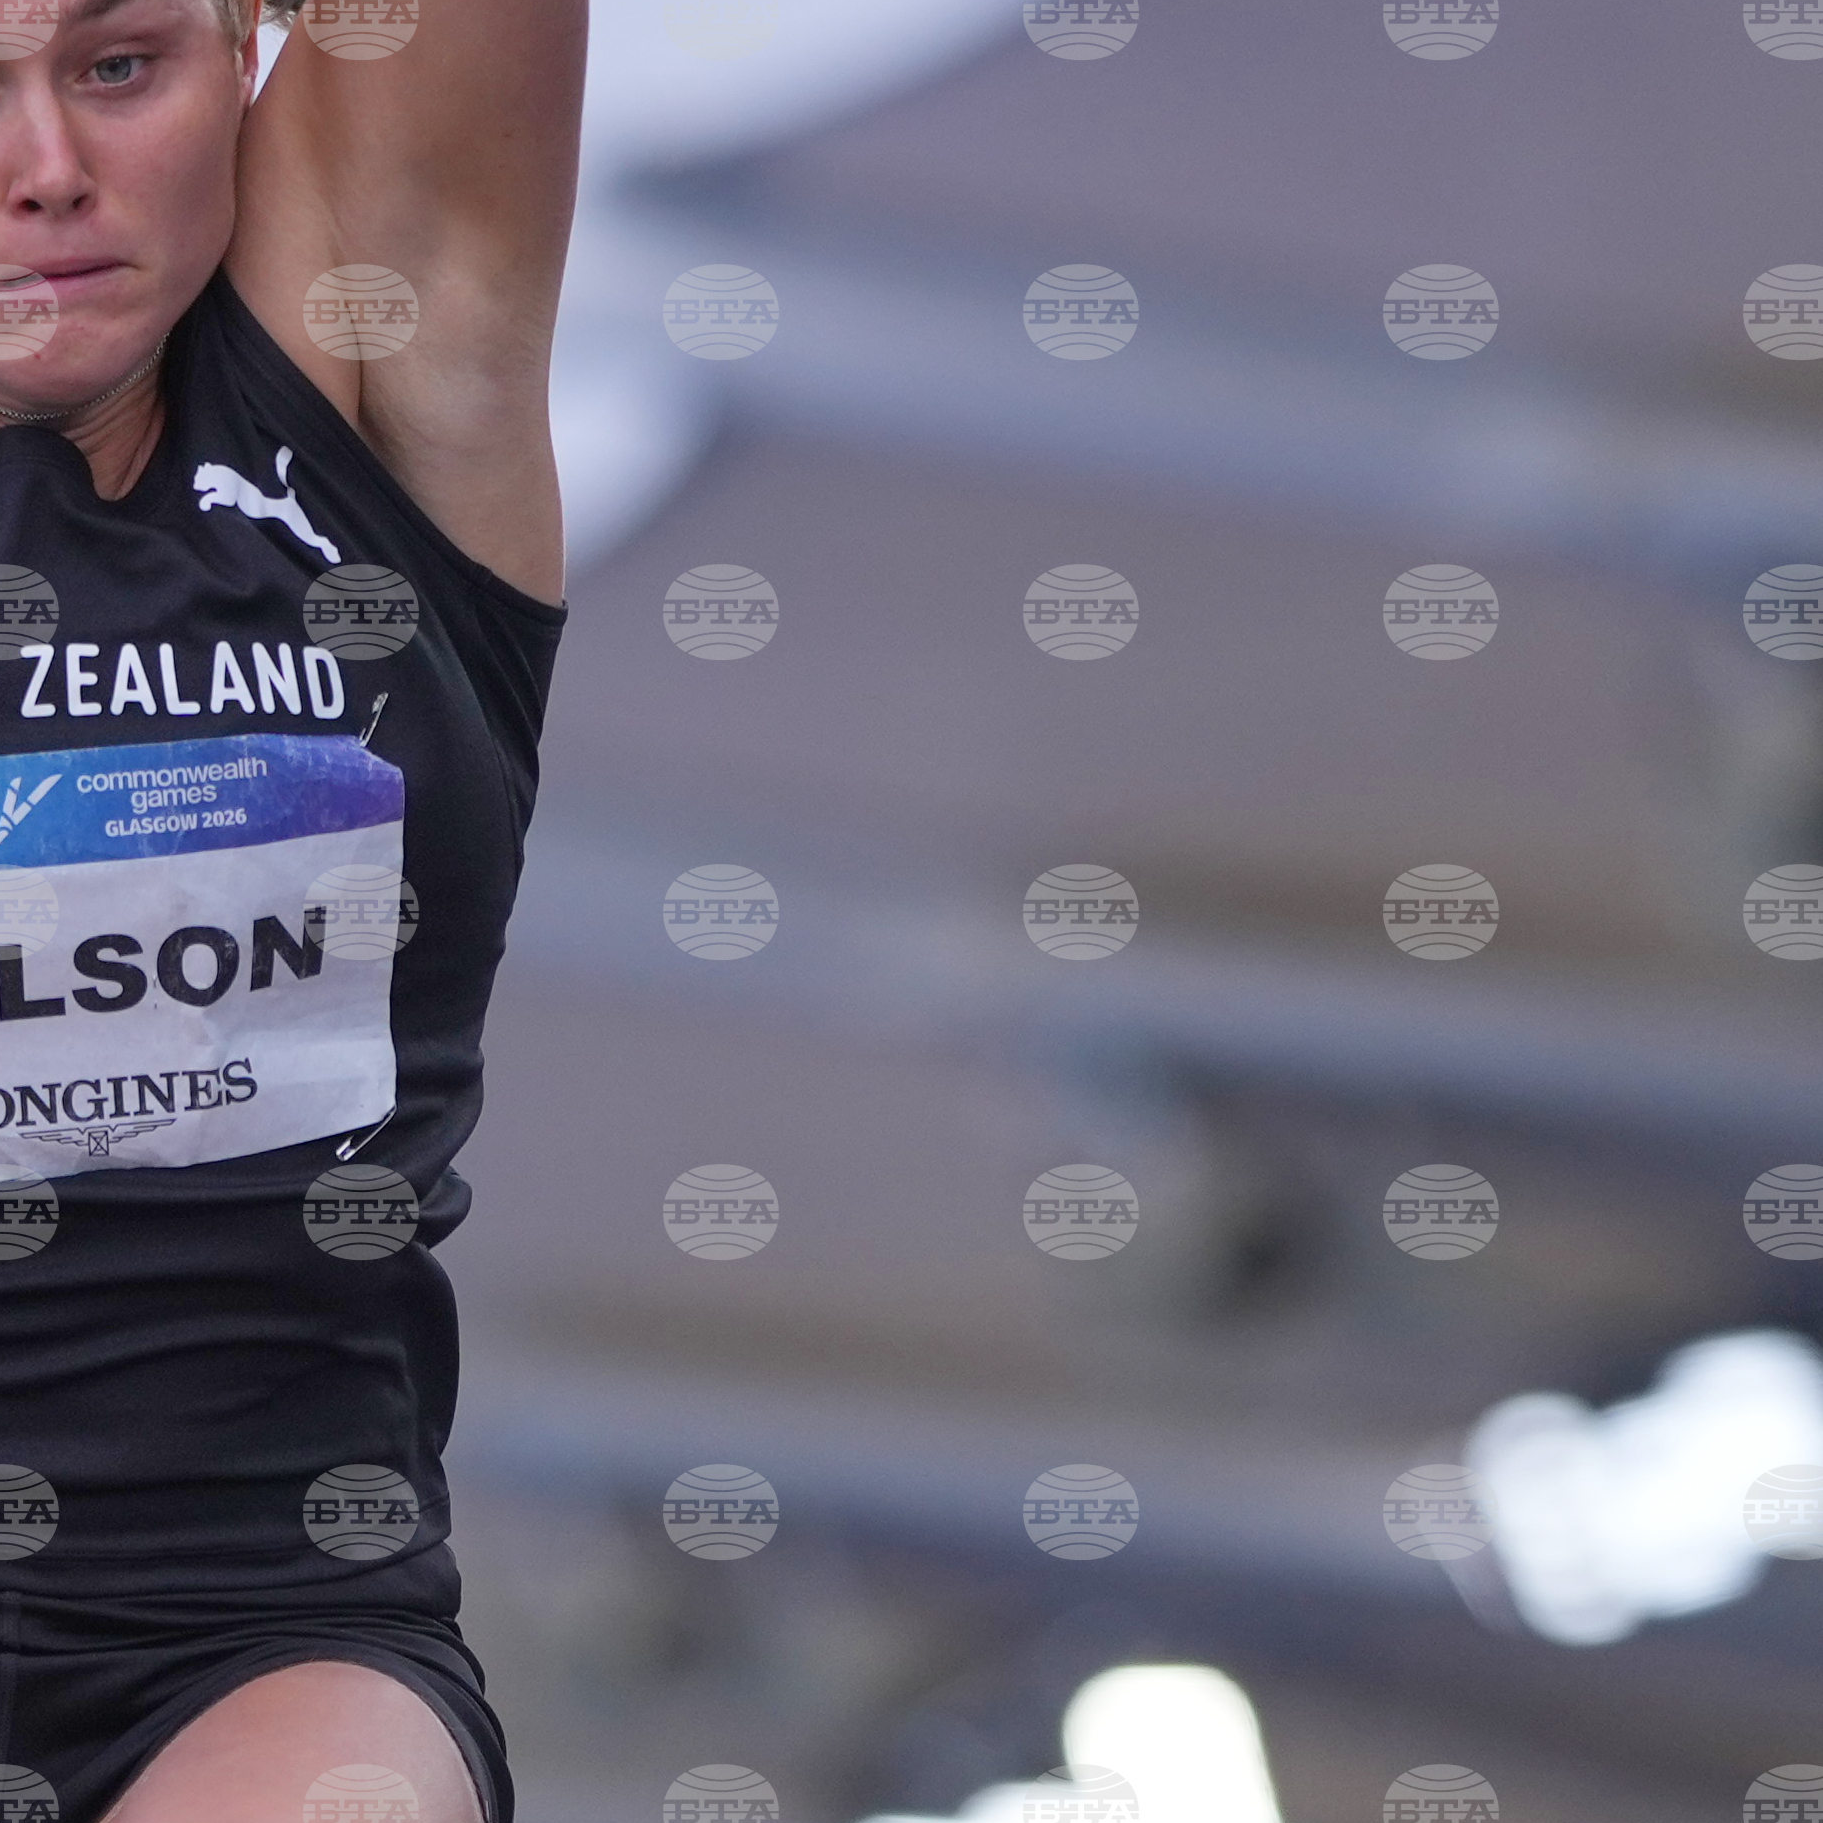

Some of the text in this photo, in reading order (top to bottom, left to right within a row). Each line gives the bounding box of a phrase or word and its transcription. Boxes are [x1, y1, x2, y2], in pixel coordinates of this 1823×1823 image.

[20, 641, 346, 720] ZEALAND
[77, 757, 267, 793] commonwealth
[131, 784, 217, 814] games
[105, 808, 247, 837] GLASGOW 2026
